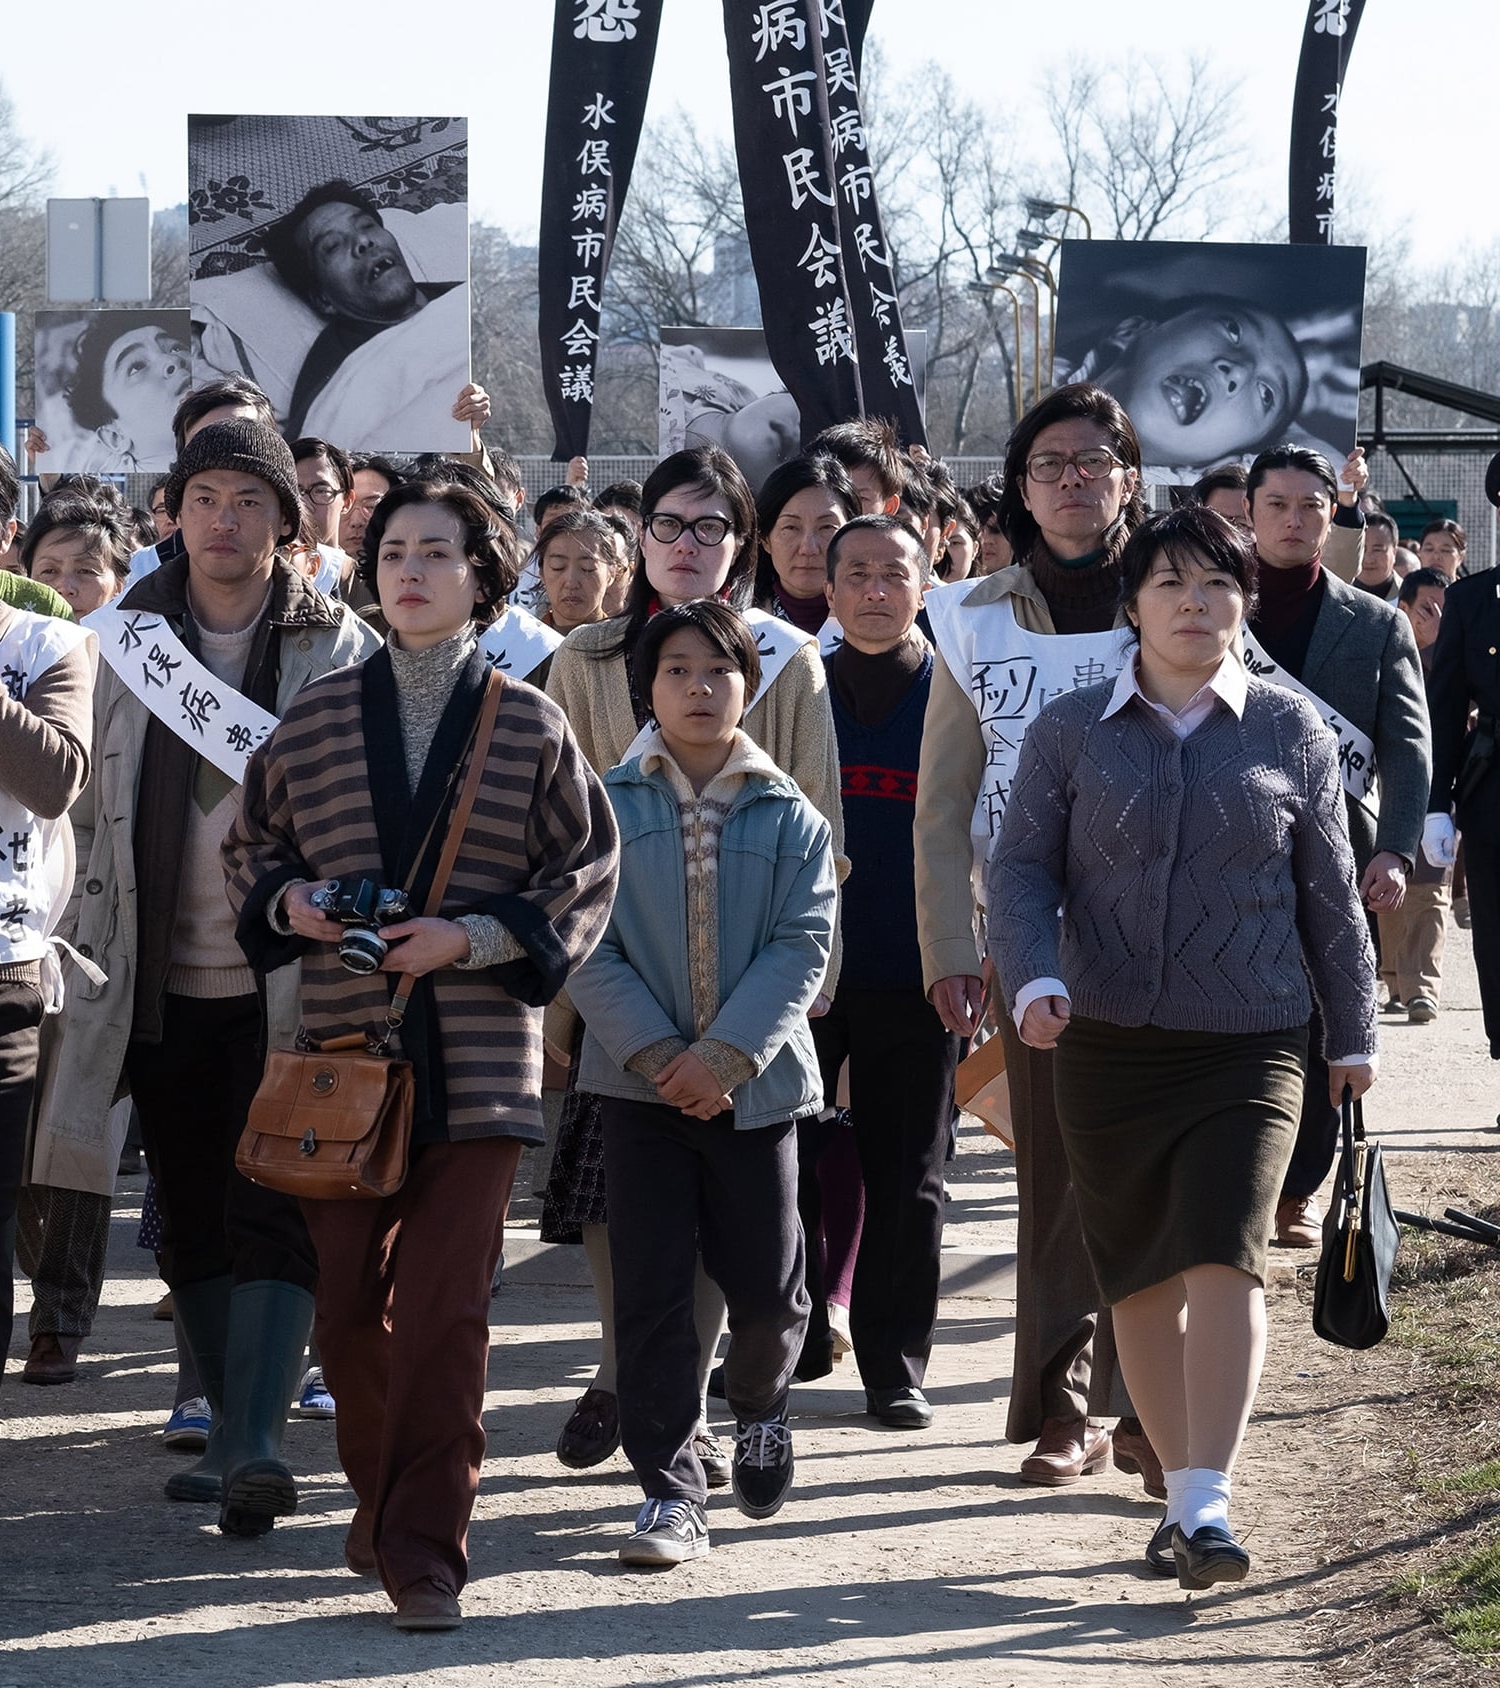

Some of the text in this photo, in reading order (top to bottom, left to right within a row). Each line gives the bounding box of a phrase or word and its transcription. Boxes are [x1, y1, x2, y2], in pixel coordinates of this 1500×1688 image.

[559, 92, 617, 405] 水俣病市民会議
[751, 0, 858, 367] 病市民会議
